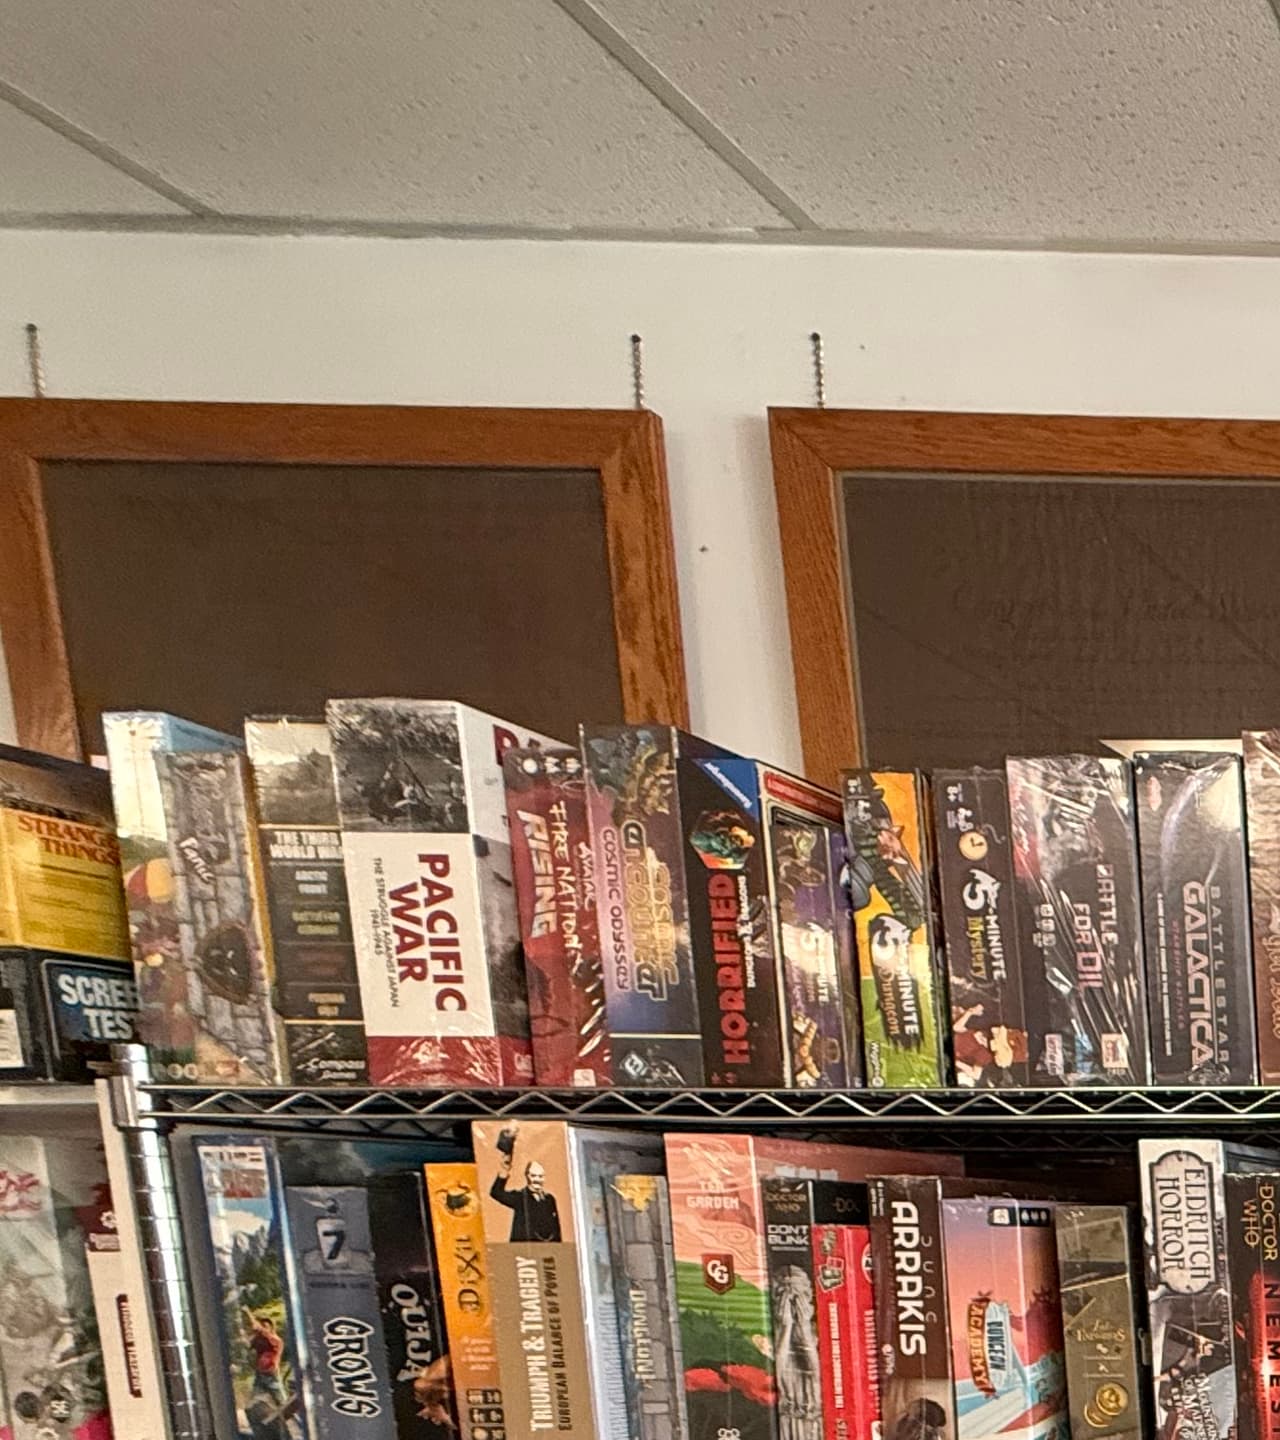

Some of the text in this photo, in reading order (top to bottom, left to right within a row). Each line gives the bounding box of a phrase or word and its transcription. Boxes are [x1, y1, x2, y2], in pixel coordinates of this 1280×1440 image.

[388, 884, 429, 982] WAR
[418, 854, 468, 1014] PACIFIC
[708, 872, 750, 1064] HORRIFIED
[1182, 882, 1214, 1070] GALACTICA
[1209, 885, 1229, 1065] BATTLESTAR
[687, 1193, 740, 1210] GARDEN
[1157, 1177, 1185, 1272] HORROR
[1183, 1168, 1211, 1280] ELDRITCH
[1243, 1200, 1259, 1248] WHO
[1260, 1183, 1279, 1261] DOCTOR
[391, 1283, 431, 1382] OUIJA
[891, 1200, 926, 1356] ARRAKIS
[515, 1256, 553, 1432] TRIUMPH & TRAGEDY
